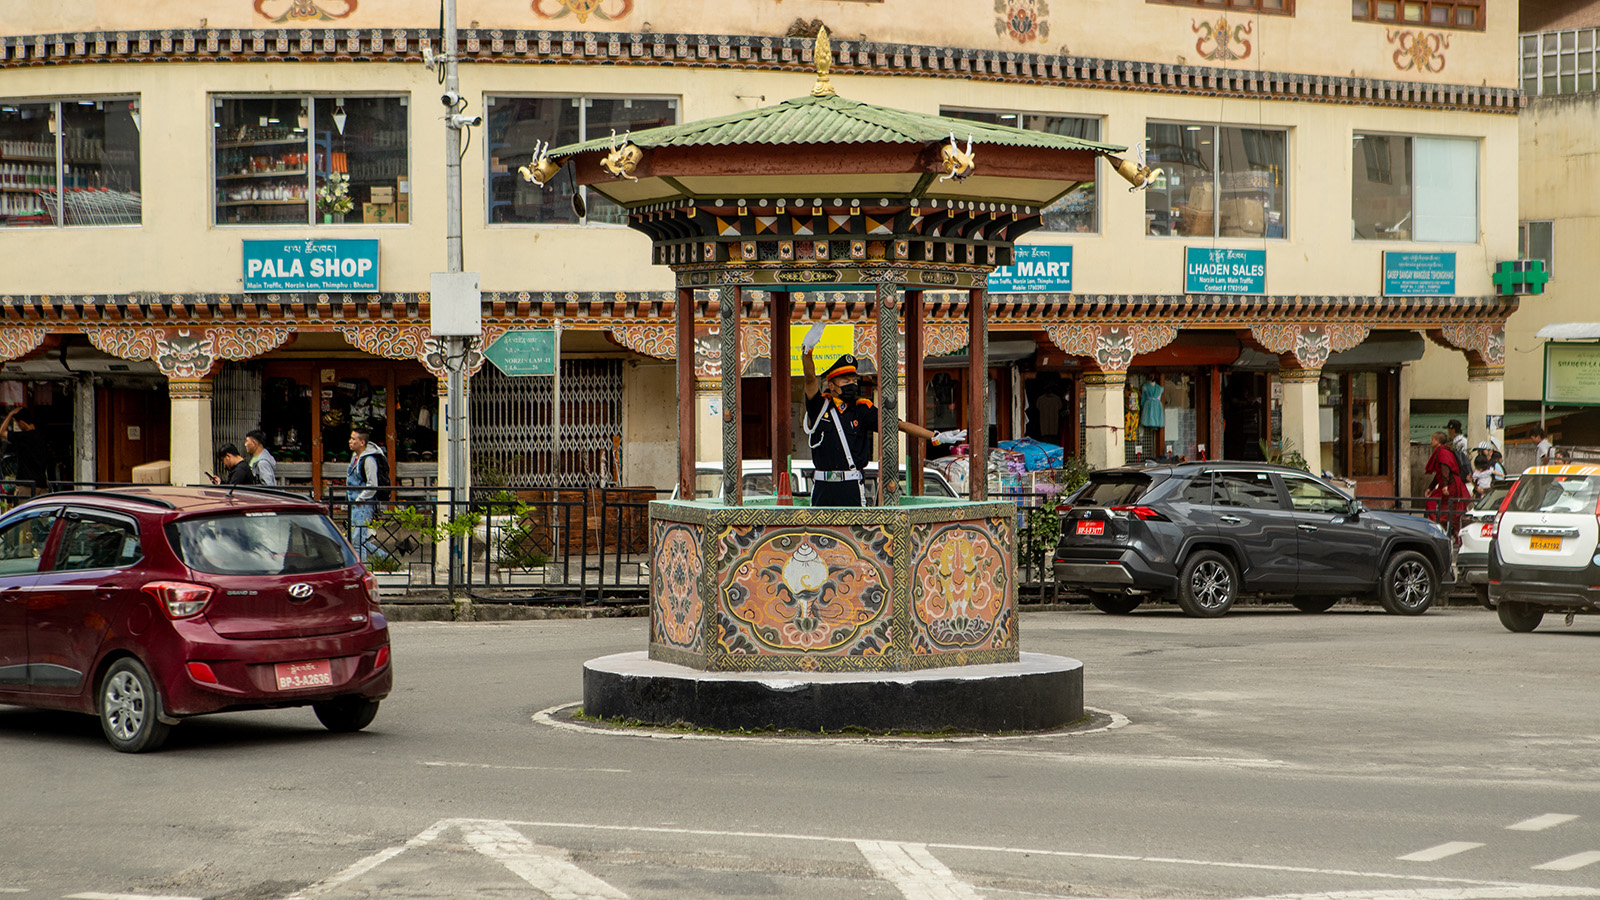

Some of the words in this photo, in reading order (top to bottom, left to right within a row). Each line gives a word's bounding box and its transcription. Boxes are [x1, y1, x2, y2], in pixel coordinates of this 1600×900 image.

[248, 258, 304, 278] PALA
[310, 258, 372, 278] SHOP
[1018, 262, 1070, 277] MART
[1189, 264, 1229, 275] LHADEN
[1232, 265, 1264, 276] SALES
[280, 673, 330, 687] BP-3-A2636
